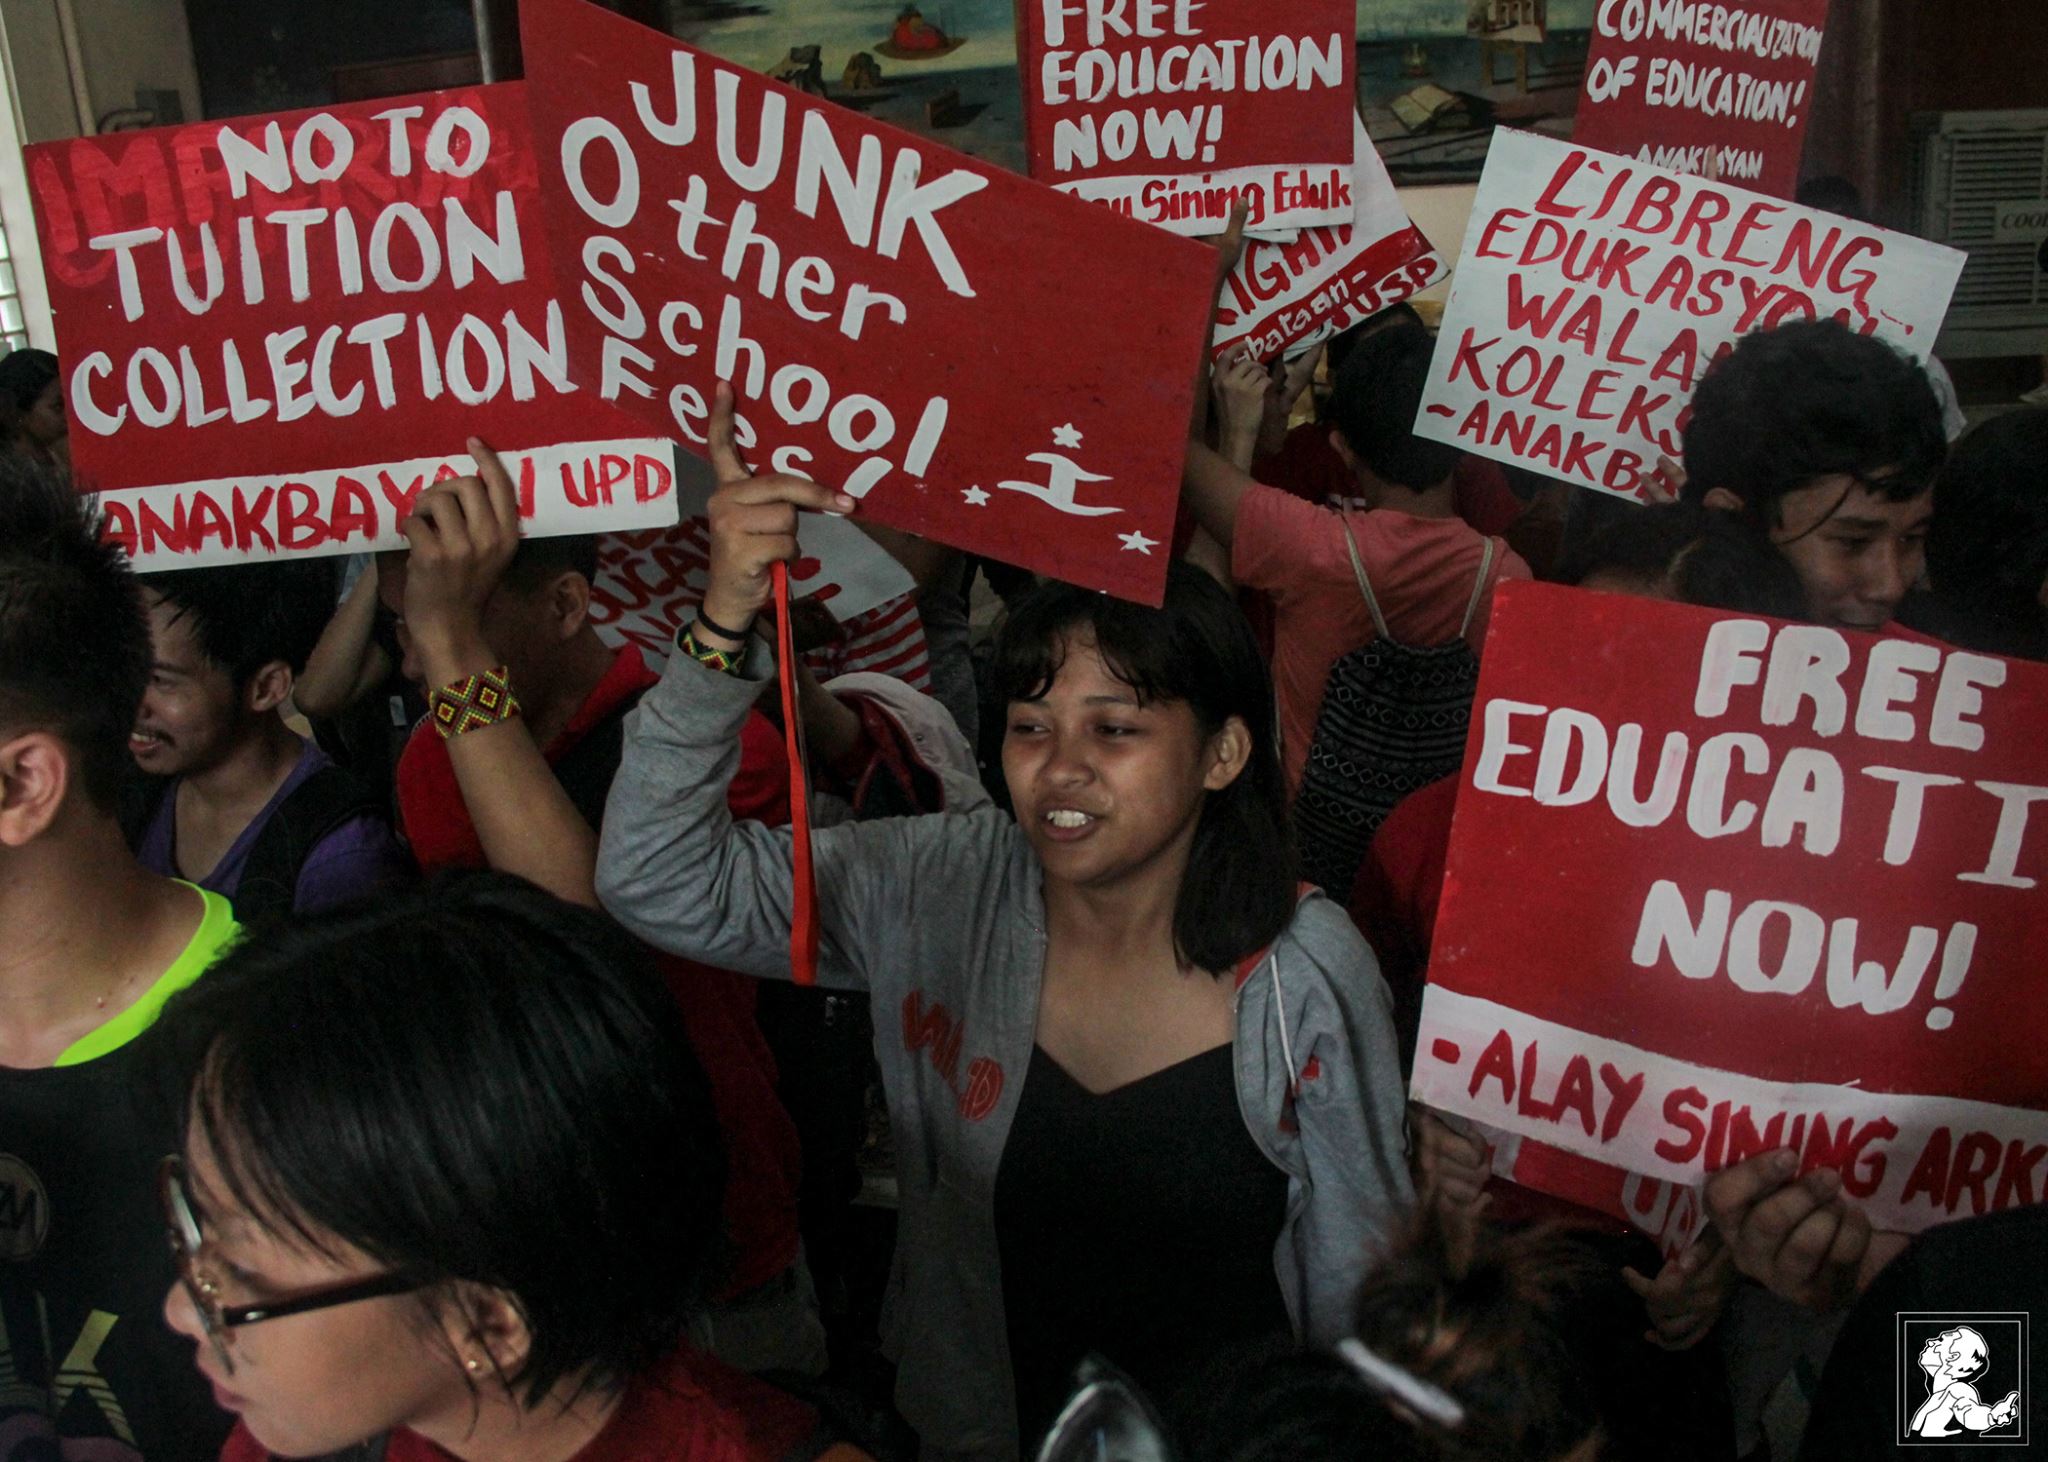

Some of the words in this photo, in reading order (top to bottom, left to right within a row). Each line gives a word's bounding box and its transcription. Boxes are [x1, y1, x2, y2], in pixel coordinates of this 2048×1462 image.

[1041, 33, 1342, 104] EDUCATION
[1587, 56, 1639, 103] OF
[1645, 57, 1806, 129] EDUCATION!
[217, 112, 354, 199] NO
[371, 106, 490, 178] TO
[629, 50, 988, 298] JUNK
[1053, 105, 1222, 171] NOW!
[1273, 169, 1353, 213] Eduk
[90, 190, 526, 322] TUITION
[561, 116, 906, 340] Other
[1534, 151, 1884, 295] LIBRENG
[71, 298, 579, 436] COLLECTION
[581, 235, 948, 478] School
[560, 453, 672, 507] UPD
[1694, 619, 2006, 751] FREE
[1473, 698, 2048, 889] EDUCATI
[1631, 879, 1978, 1030] NOW!
[1432, 1029, 1644, 1144] -ALAY
